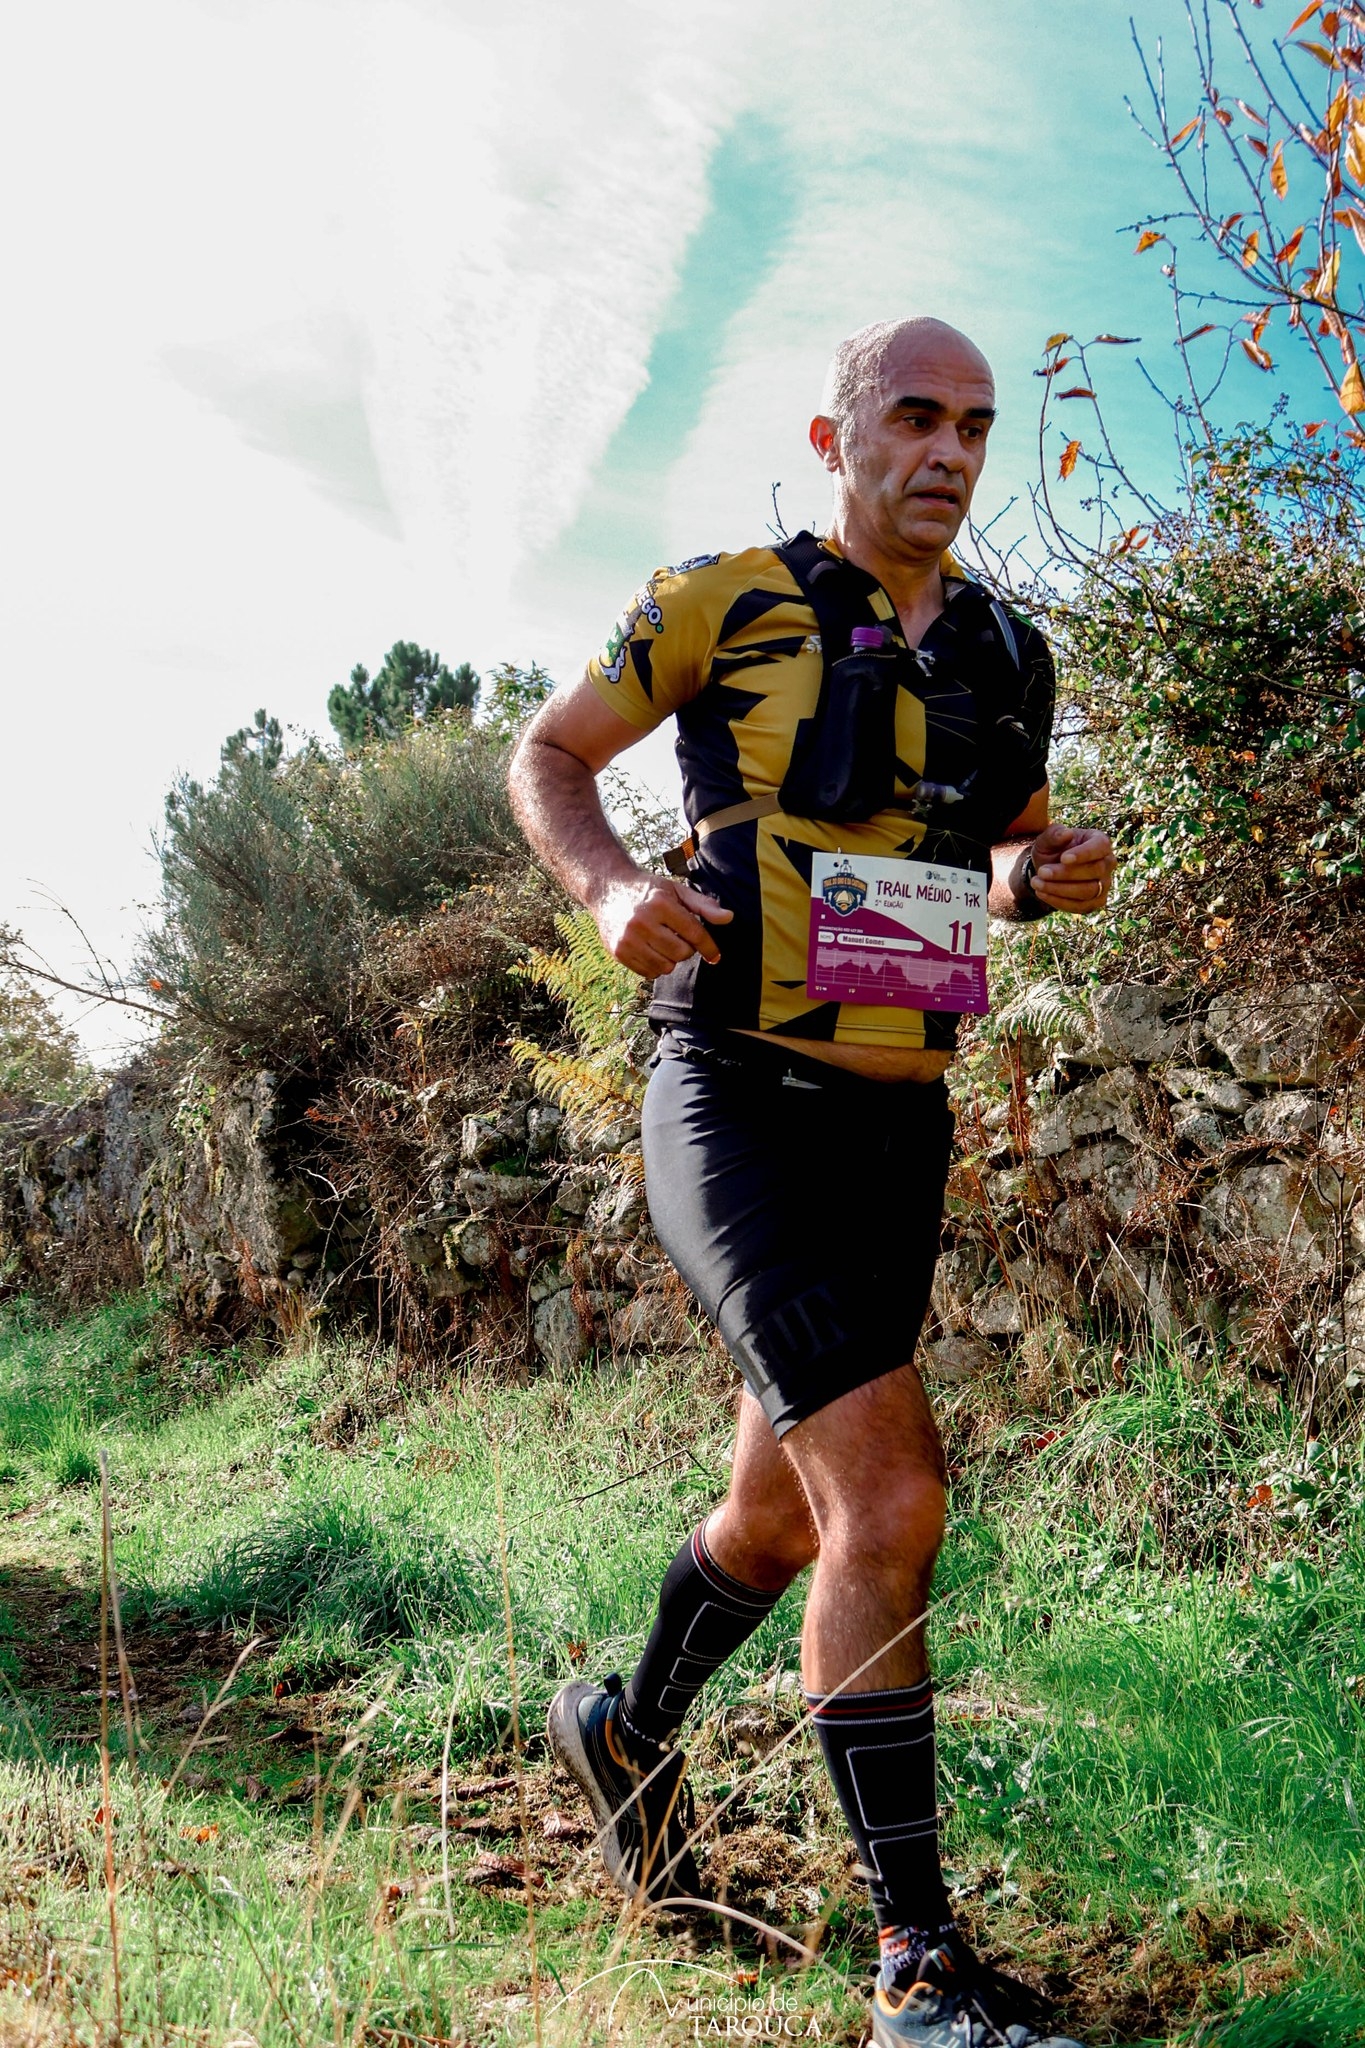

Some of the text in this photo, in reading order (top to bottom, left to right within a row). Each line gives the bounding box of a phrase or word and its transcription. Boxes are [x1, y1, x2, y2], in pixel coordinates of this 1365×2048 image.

[876, 880, 912, 898] TRAIL
[916, 884, 952, 904] MÉDIO
[964, 892, 980, 908] 17K
[843, 935, 885, 946] Manuel Gomes
[949, 920, 972, 954] 11
